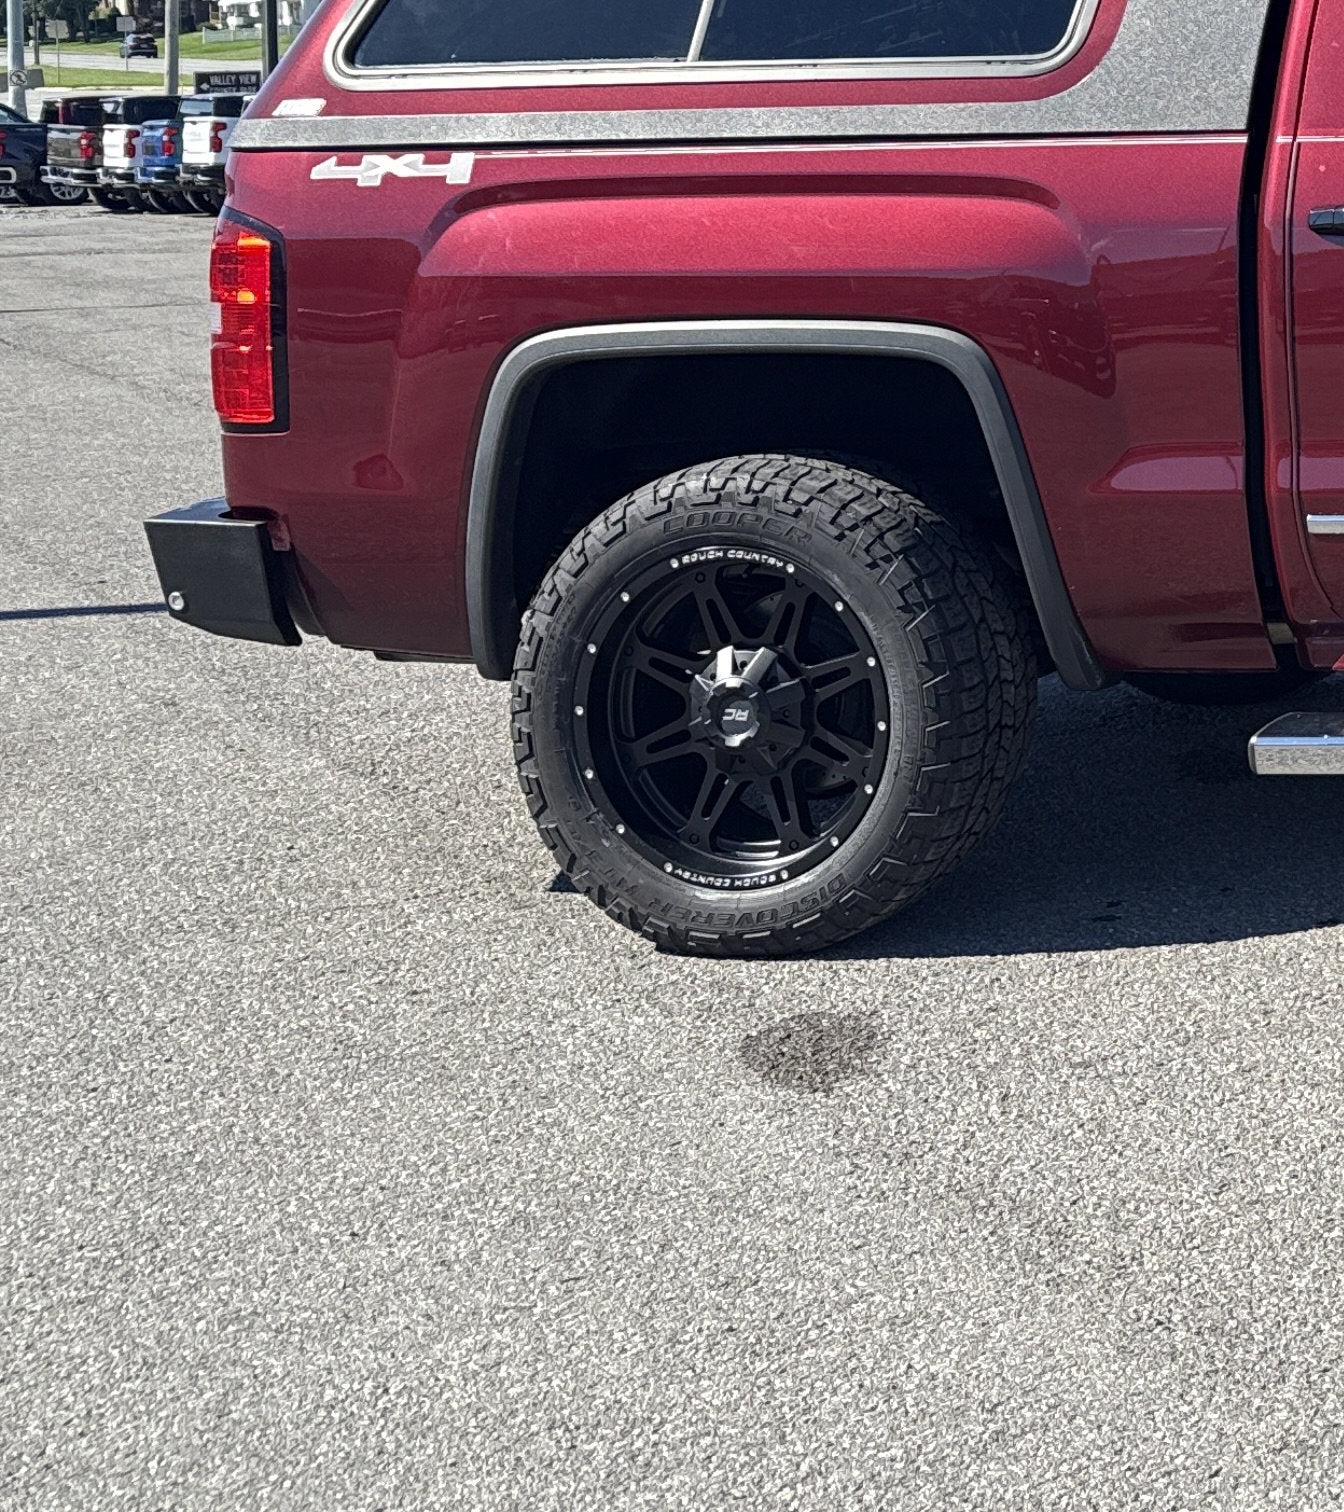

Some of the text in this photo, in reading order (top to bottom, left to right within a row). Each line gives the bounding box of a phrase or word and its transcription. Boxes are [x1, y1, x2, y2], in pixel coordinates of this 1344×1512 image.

[663, 510, 813, 547] COOPER
[682, 549, 784, 568] ROUGH COUNTRY
